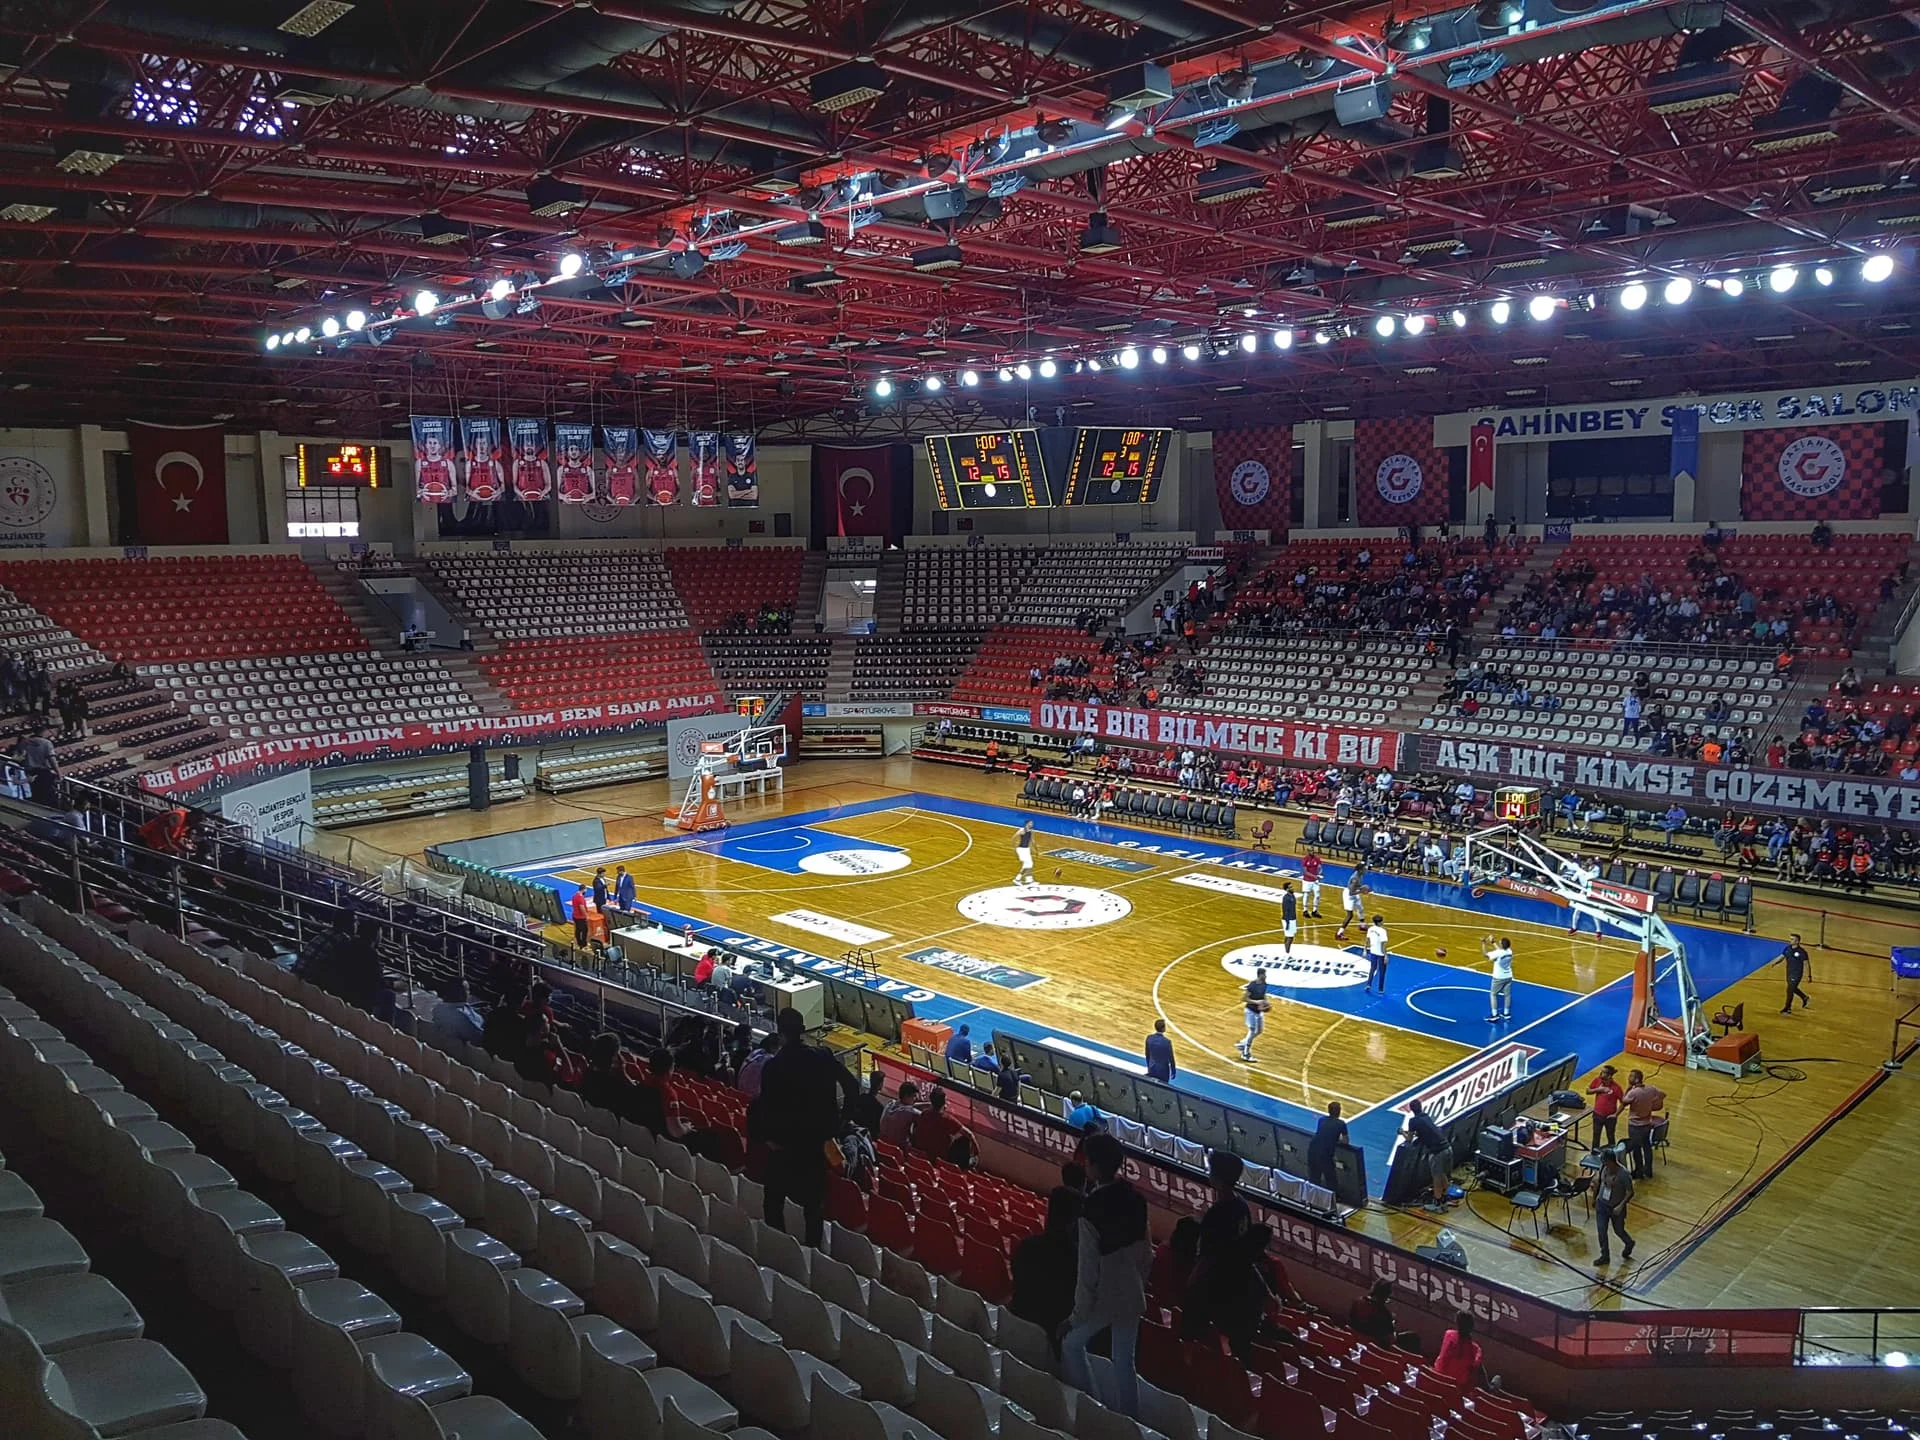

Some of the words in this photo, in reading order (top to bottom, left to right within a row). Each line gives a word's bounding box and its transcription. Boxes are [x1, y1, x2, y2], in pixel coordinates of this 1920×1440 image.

[976, 435, 996, 449] 1:00
[981, 451, 986, 462] 3
[1120, 446, 1127, 458] 3
[968, 466, 980, 480] 12
[997, 465, 1010, 479] 15
[1103, 462, 1115, 476] 12
[1127, 462, 1139, 476] 15
[264, 727, 404, 757] TUTULDUM
[427, 711, 554, 735] TUTULDUM
[561, 705, 602, 722] BEN
[607, 698, 661, 717] SANA
[667, 694, 715, 710] ANLA
[1337, 734, 1383, 765] BU
[1436, 740, 1499, 776] AŞK
[273, 813, 280, 823] VE
[281, 808, 294, 819] SPOR
[1506, 803, 1521, 816] 14
[1509, 883, 1526, 894] ING
[1638, 1038, 1663, 1053] ING
